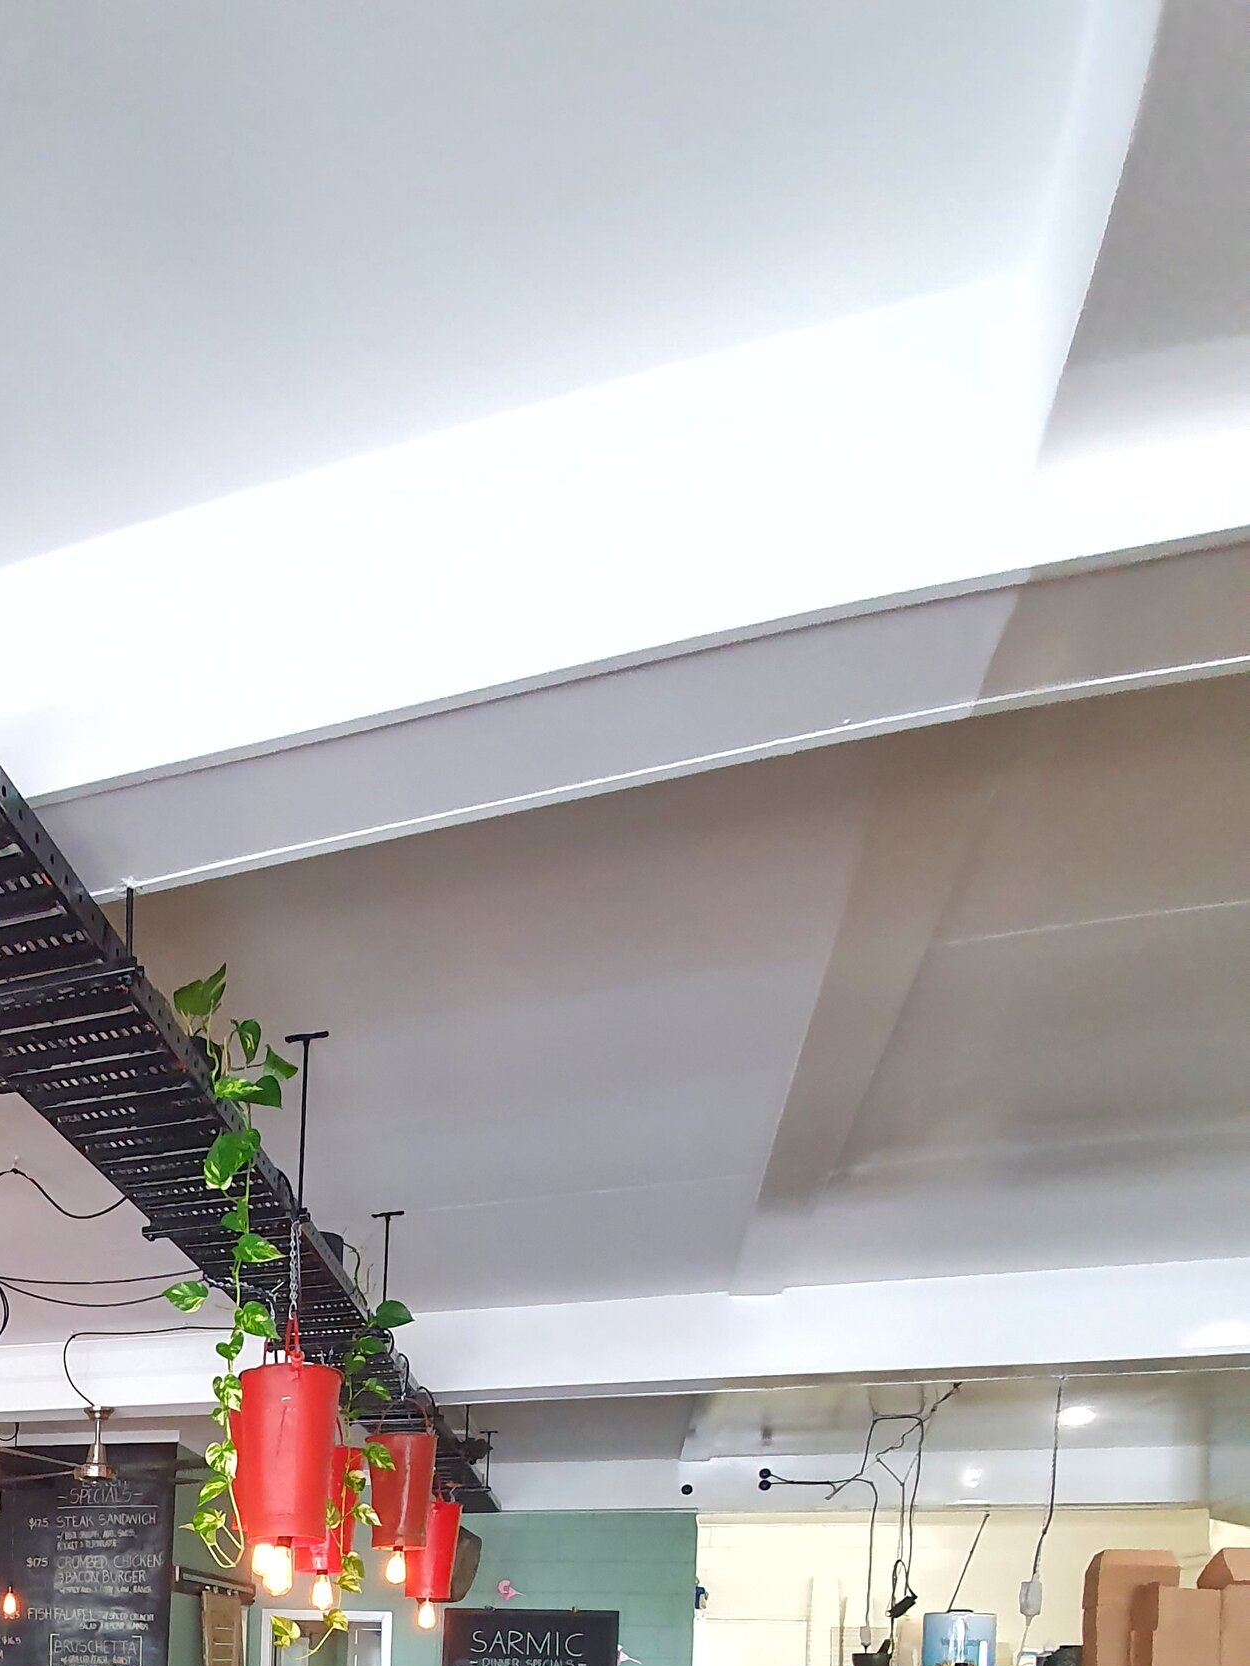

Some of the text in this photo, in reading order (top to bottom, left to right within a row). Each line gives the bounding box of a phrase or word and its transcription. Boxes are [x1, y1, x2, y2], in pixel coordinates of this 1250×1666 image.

[70, 1487, 132, 1505] SPECIALS
[56, 1515, 95, 1528] STEAK
[98, 1512, 157, 1527] SANDWICH
[56, 1555, 108, 1570] CRUMBED
[65, 1571, 99, 1584] BACON
[102, 1569, 147, 1584] BURGER
[27, 1608, 53, 1620] FISH
[54, 1607, 96, 1622] FALAFEL
[53, 1639, 138, 1656] BRUSCHETTA
[470, 1629, 585, 1657] SARMIC
